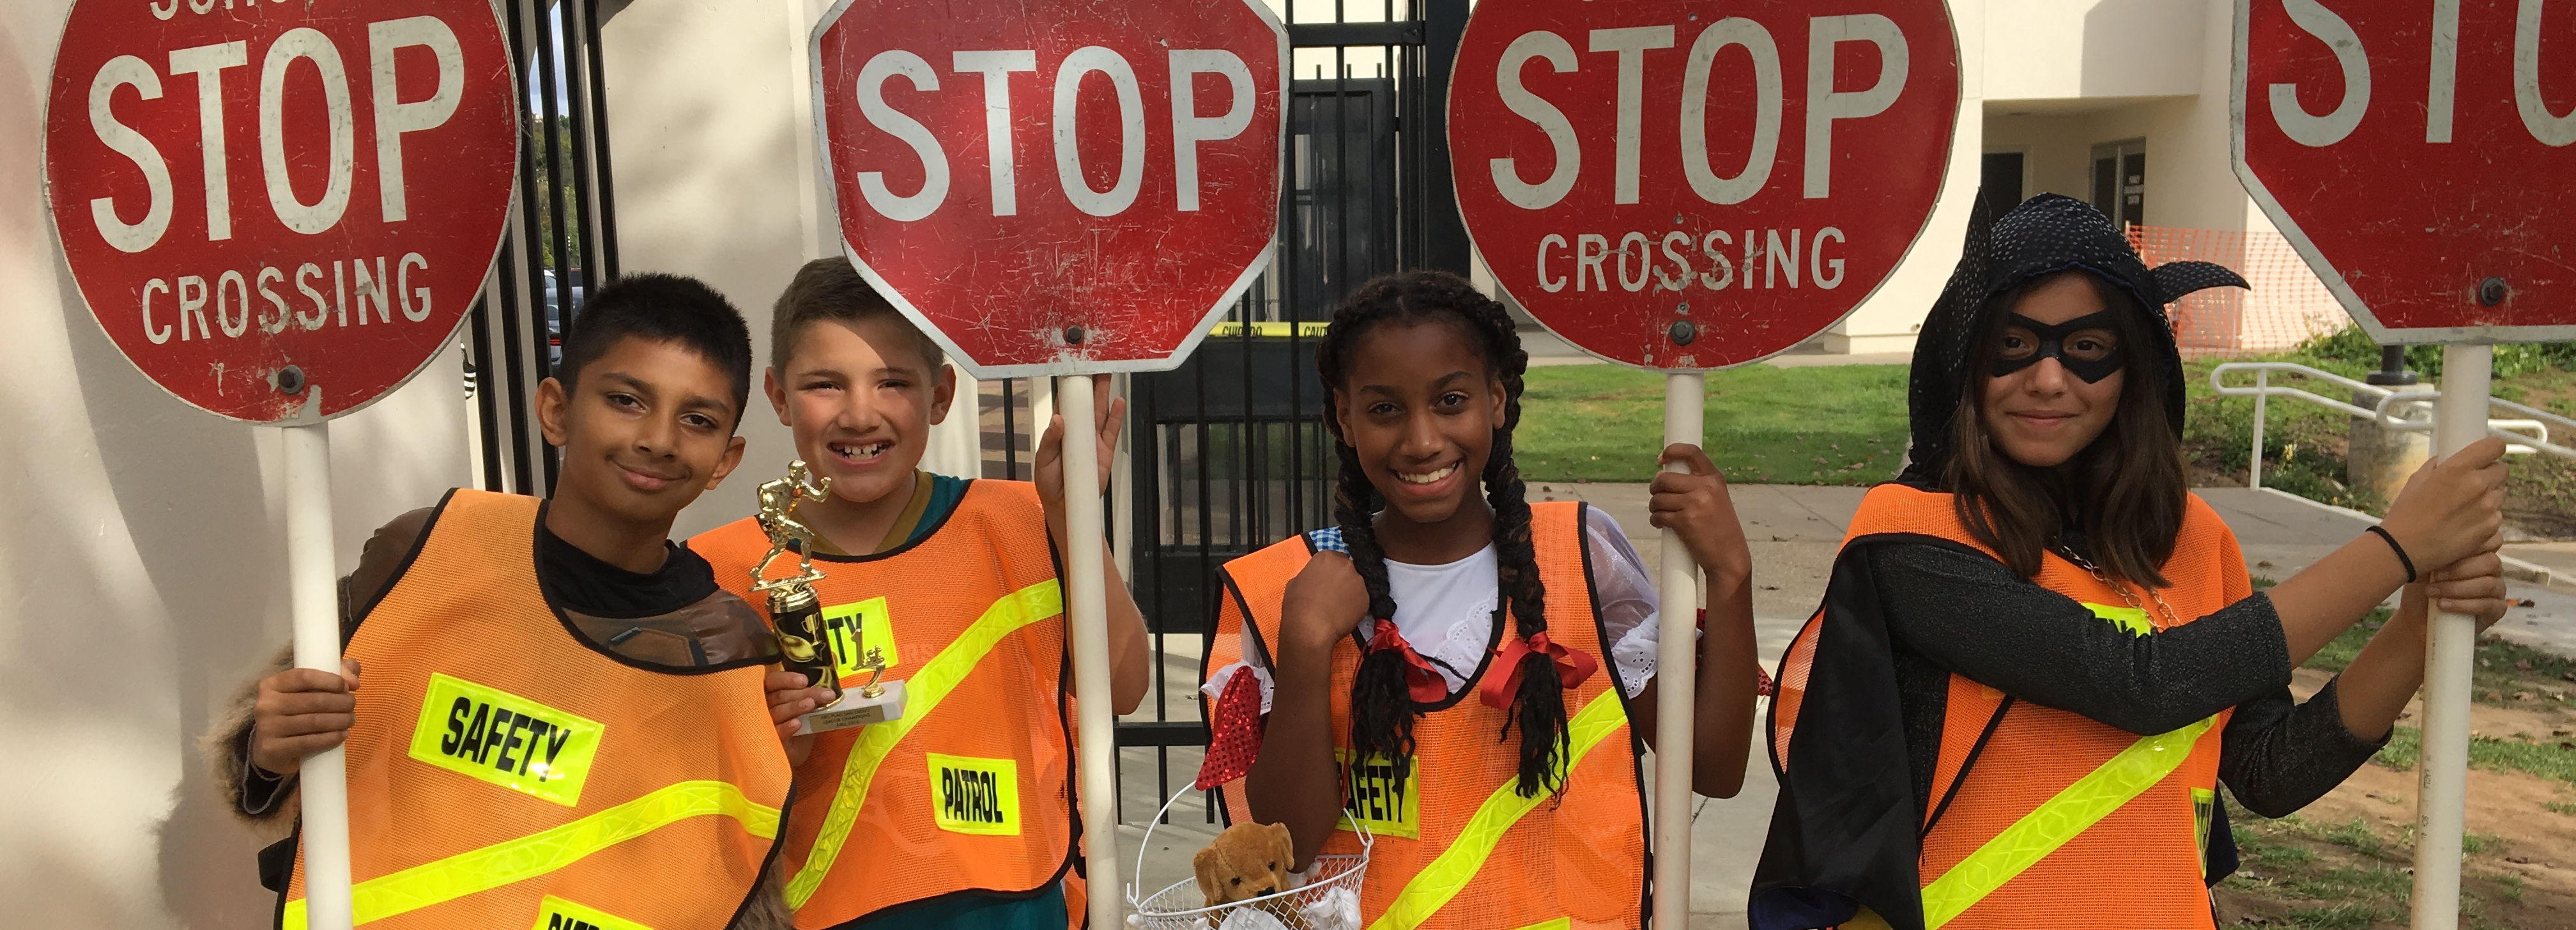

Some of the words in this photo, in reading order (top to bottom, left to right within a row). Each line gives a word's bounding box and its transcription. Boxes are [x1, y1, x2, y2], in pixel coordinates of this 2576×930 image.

[88, 15, 464, 253] STOP
[857, 45, 1256, 222] STOP
[1490, 13, 1910, 210] STOP
[142, 252, 431, 345] CROSSING
[1537, 227, 1846, 293] CROSSING
[1222, 326, 1262, 336] CUIDDO
[441, 697, 571, 782] SAFETY
[942, 767, 1003, 823] PATROL
[1337, 762, 1406, 823] AFETY
